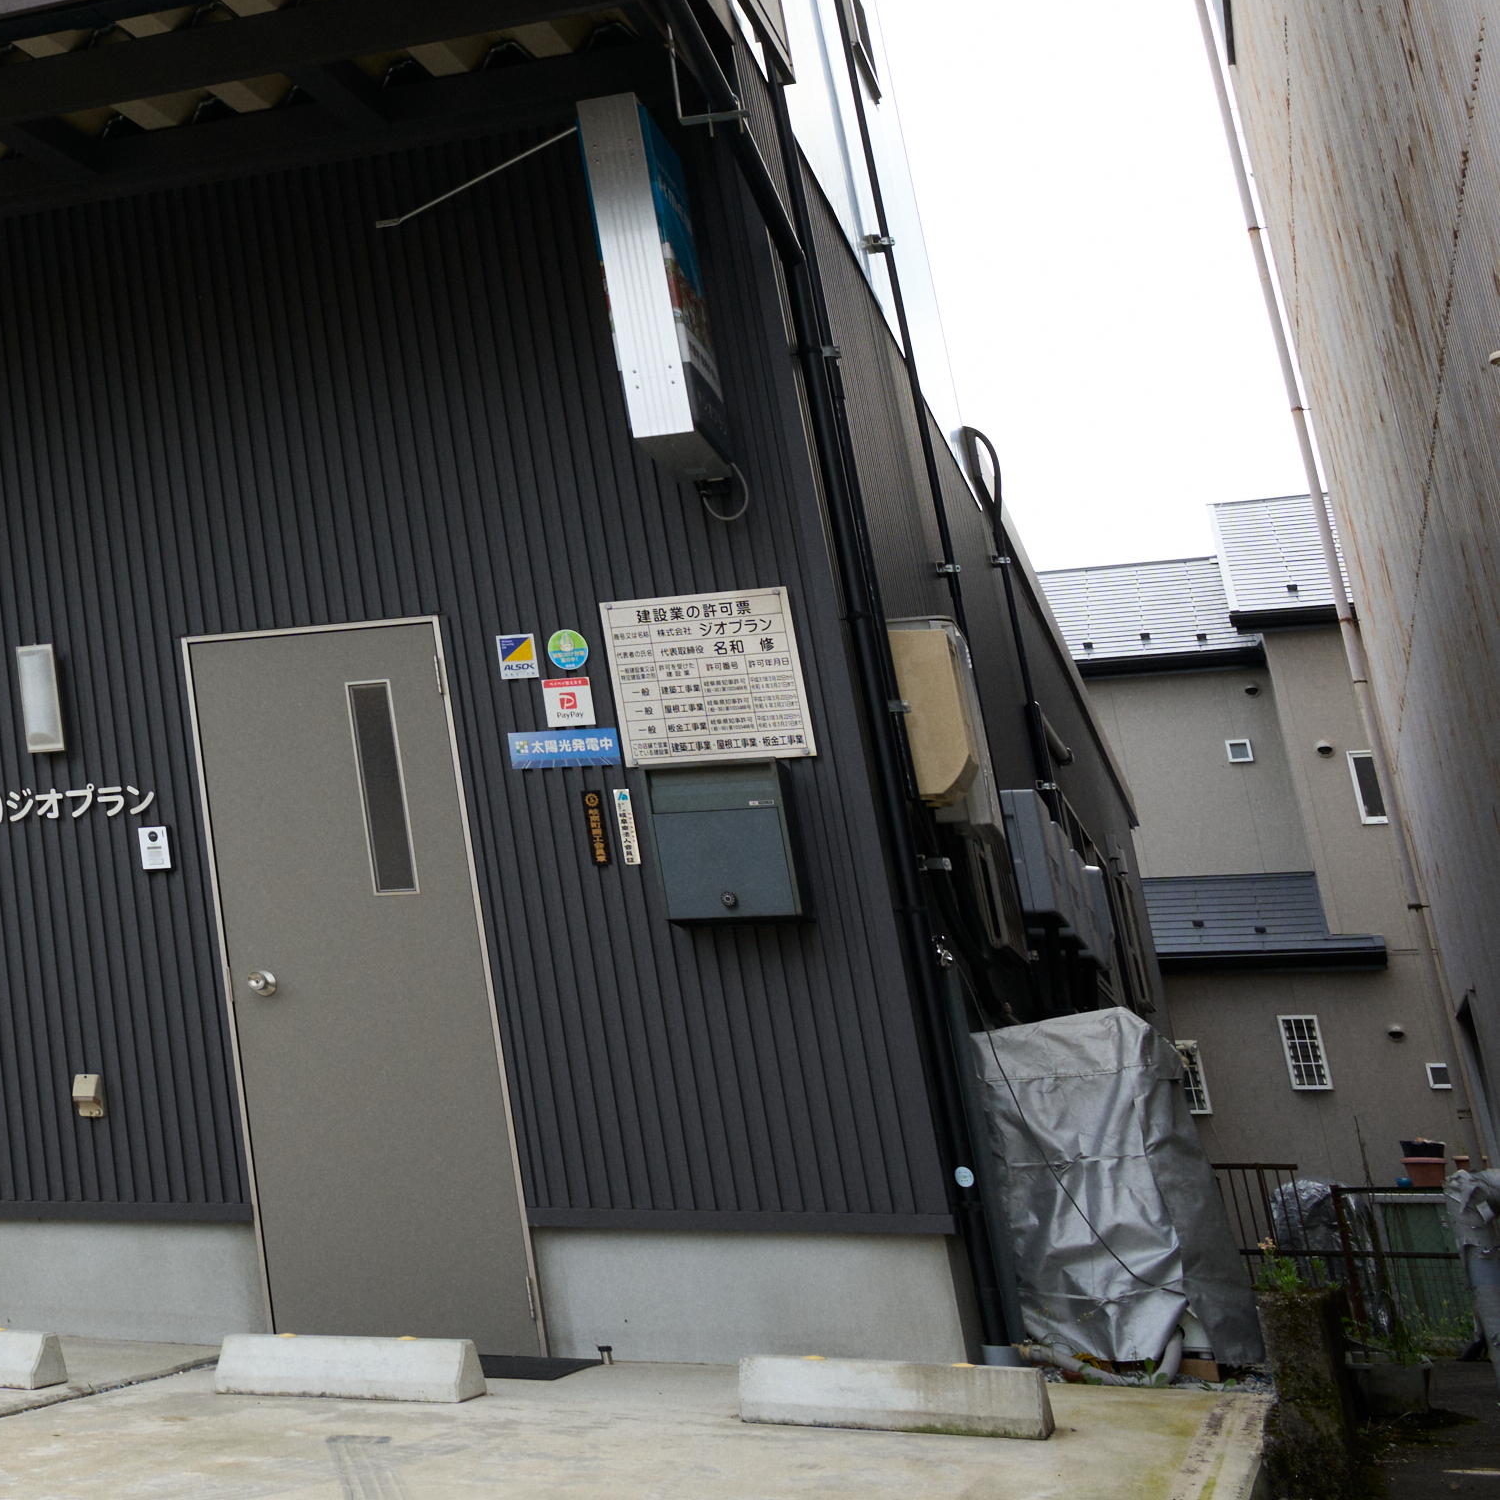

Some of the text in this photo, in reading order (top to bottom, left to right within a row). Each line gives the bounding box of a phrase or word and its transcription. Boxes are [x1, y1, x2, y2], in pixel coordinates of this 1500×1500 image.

[636, 600, 751, 623] 建設業の許可票
[657, 619, 772, 637] 株式会社 ジオプラン
[660, 645, 704, 656] 代表取締役
[504, 663, 535, 671] ALSOK
[706, 661, 738, 671] 許可番号
[748, 657, 789, 668] 許可年月日
[632, 688, 650, 696] 一般
[556, 711, 584, 720] PayPay
[635, 707, 653, 715] 一般
[638, 725, 656, 734] 一般
[531, 737, 613, 754] 太陽光発電中
